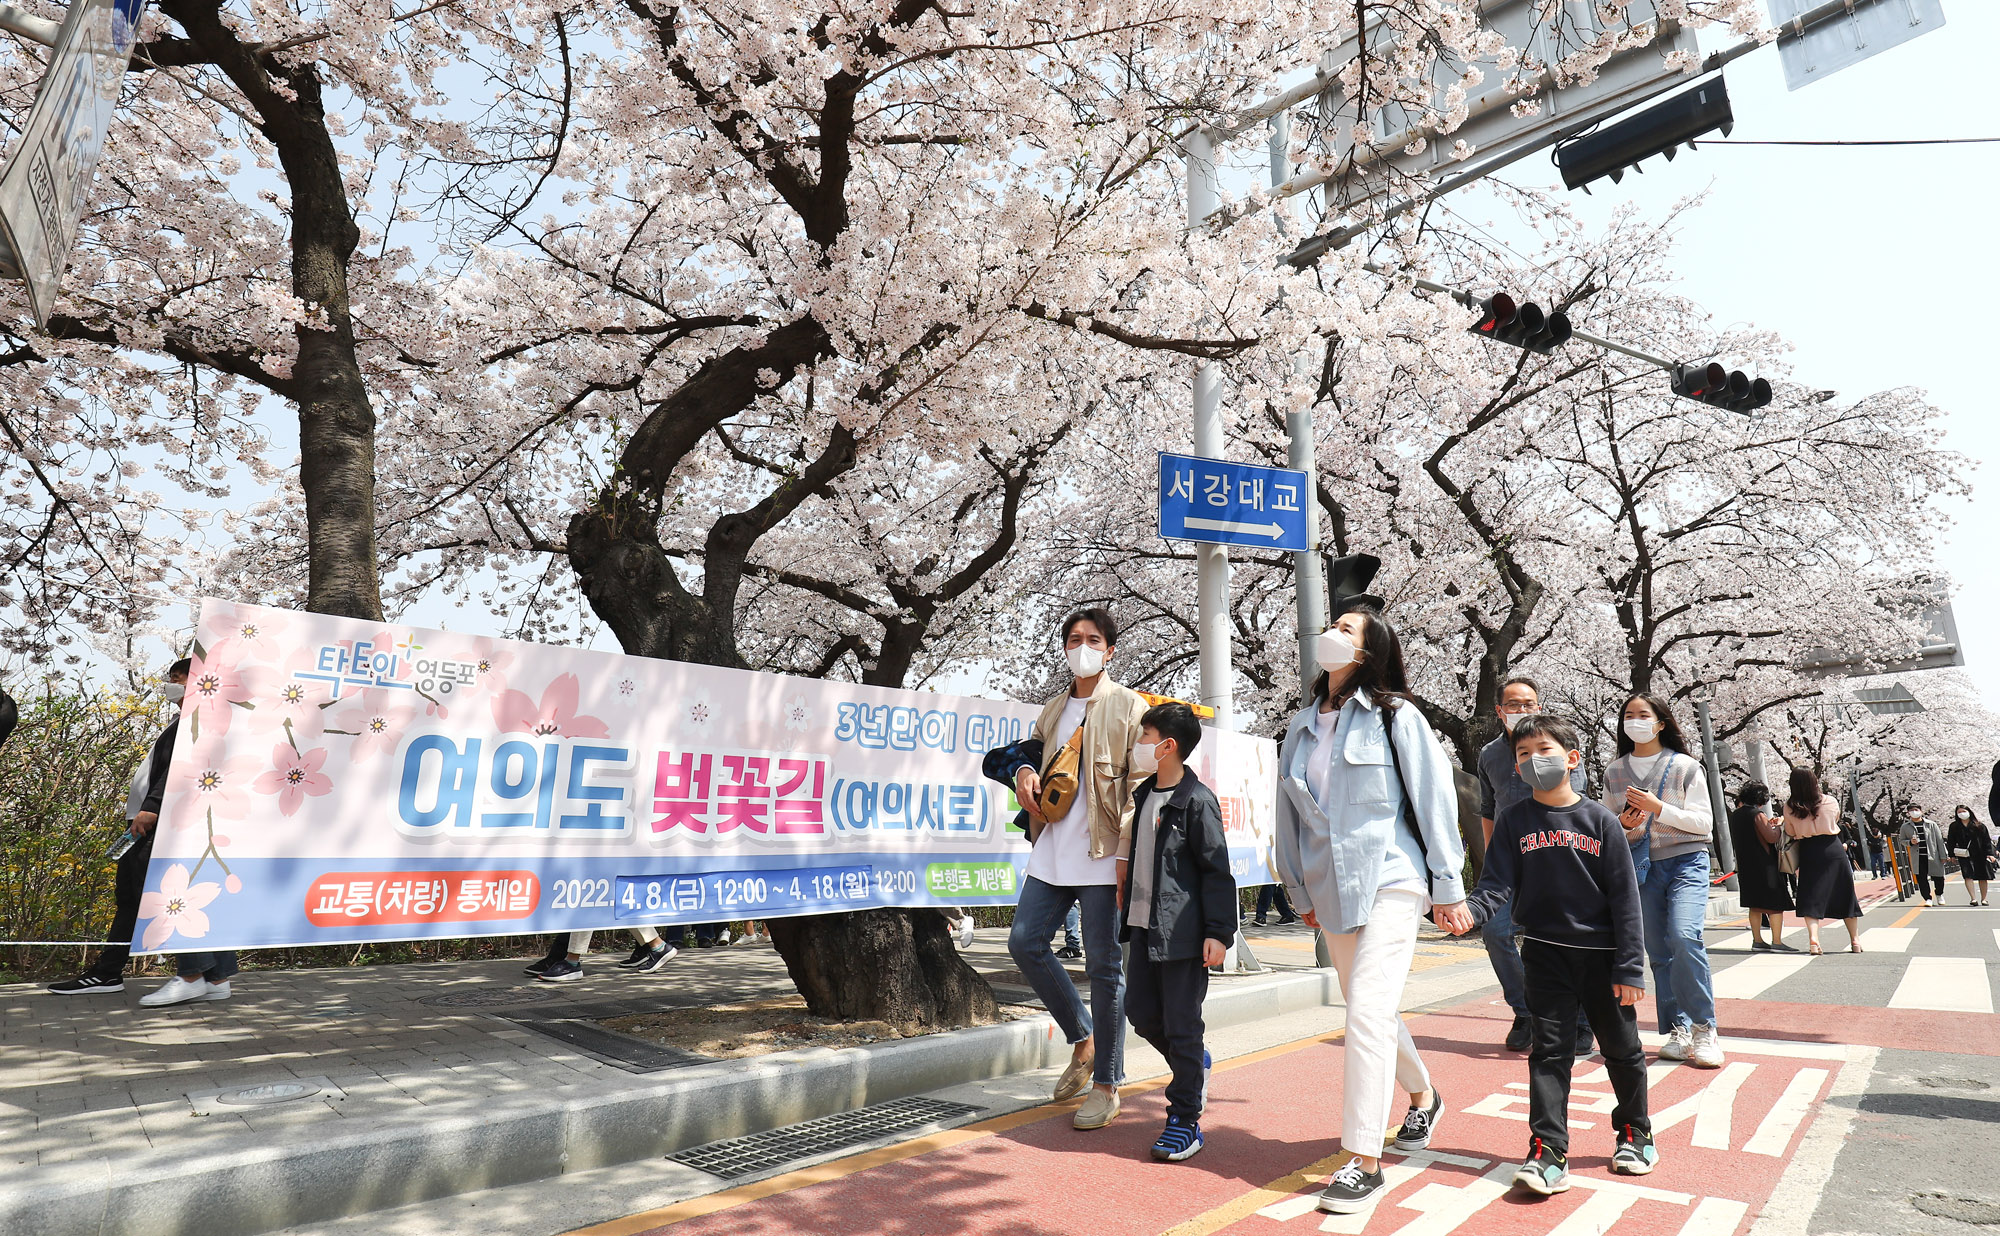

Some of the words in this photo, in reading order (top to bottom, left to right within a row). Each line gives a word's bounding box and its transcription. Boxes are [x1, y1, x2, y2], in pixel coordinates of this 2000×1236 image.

[1167, 469, 1300, 512] 서강대교
[416, 659, 476, 694] 영등포
[835, 702, 958, 753] 3년만에
[398, 734, 629, 830] 여의도
[650, 751, 825, 834] 벚꽃길
[830, 778, 989, 833] (여의서로)
[1519, 829, 1602, 858] CHAMPION
[312, 878, 449, 917] 교통(차량)
[456, 878, 533, 912] 통제일
[551, 878, 615, 909] 2022.
[713, 877, 768, 905] 12:00
[875, 870, 916, 893] 12:00
[931, 867, 973, 892] 보행로
[974, 867, 1013, 892] 개방일
